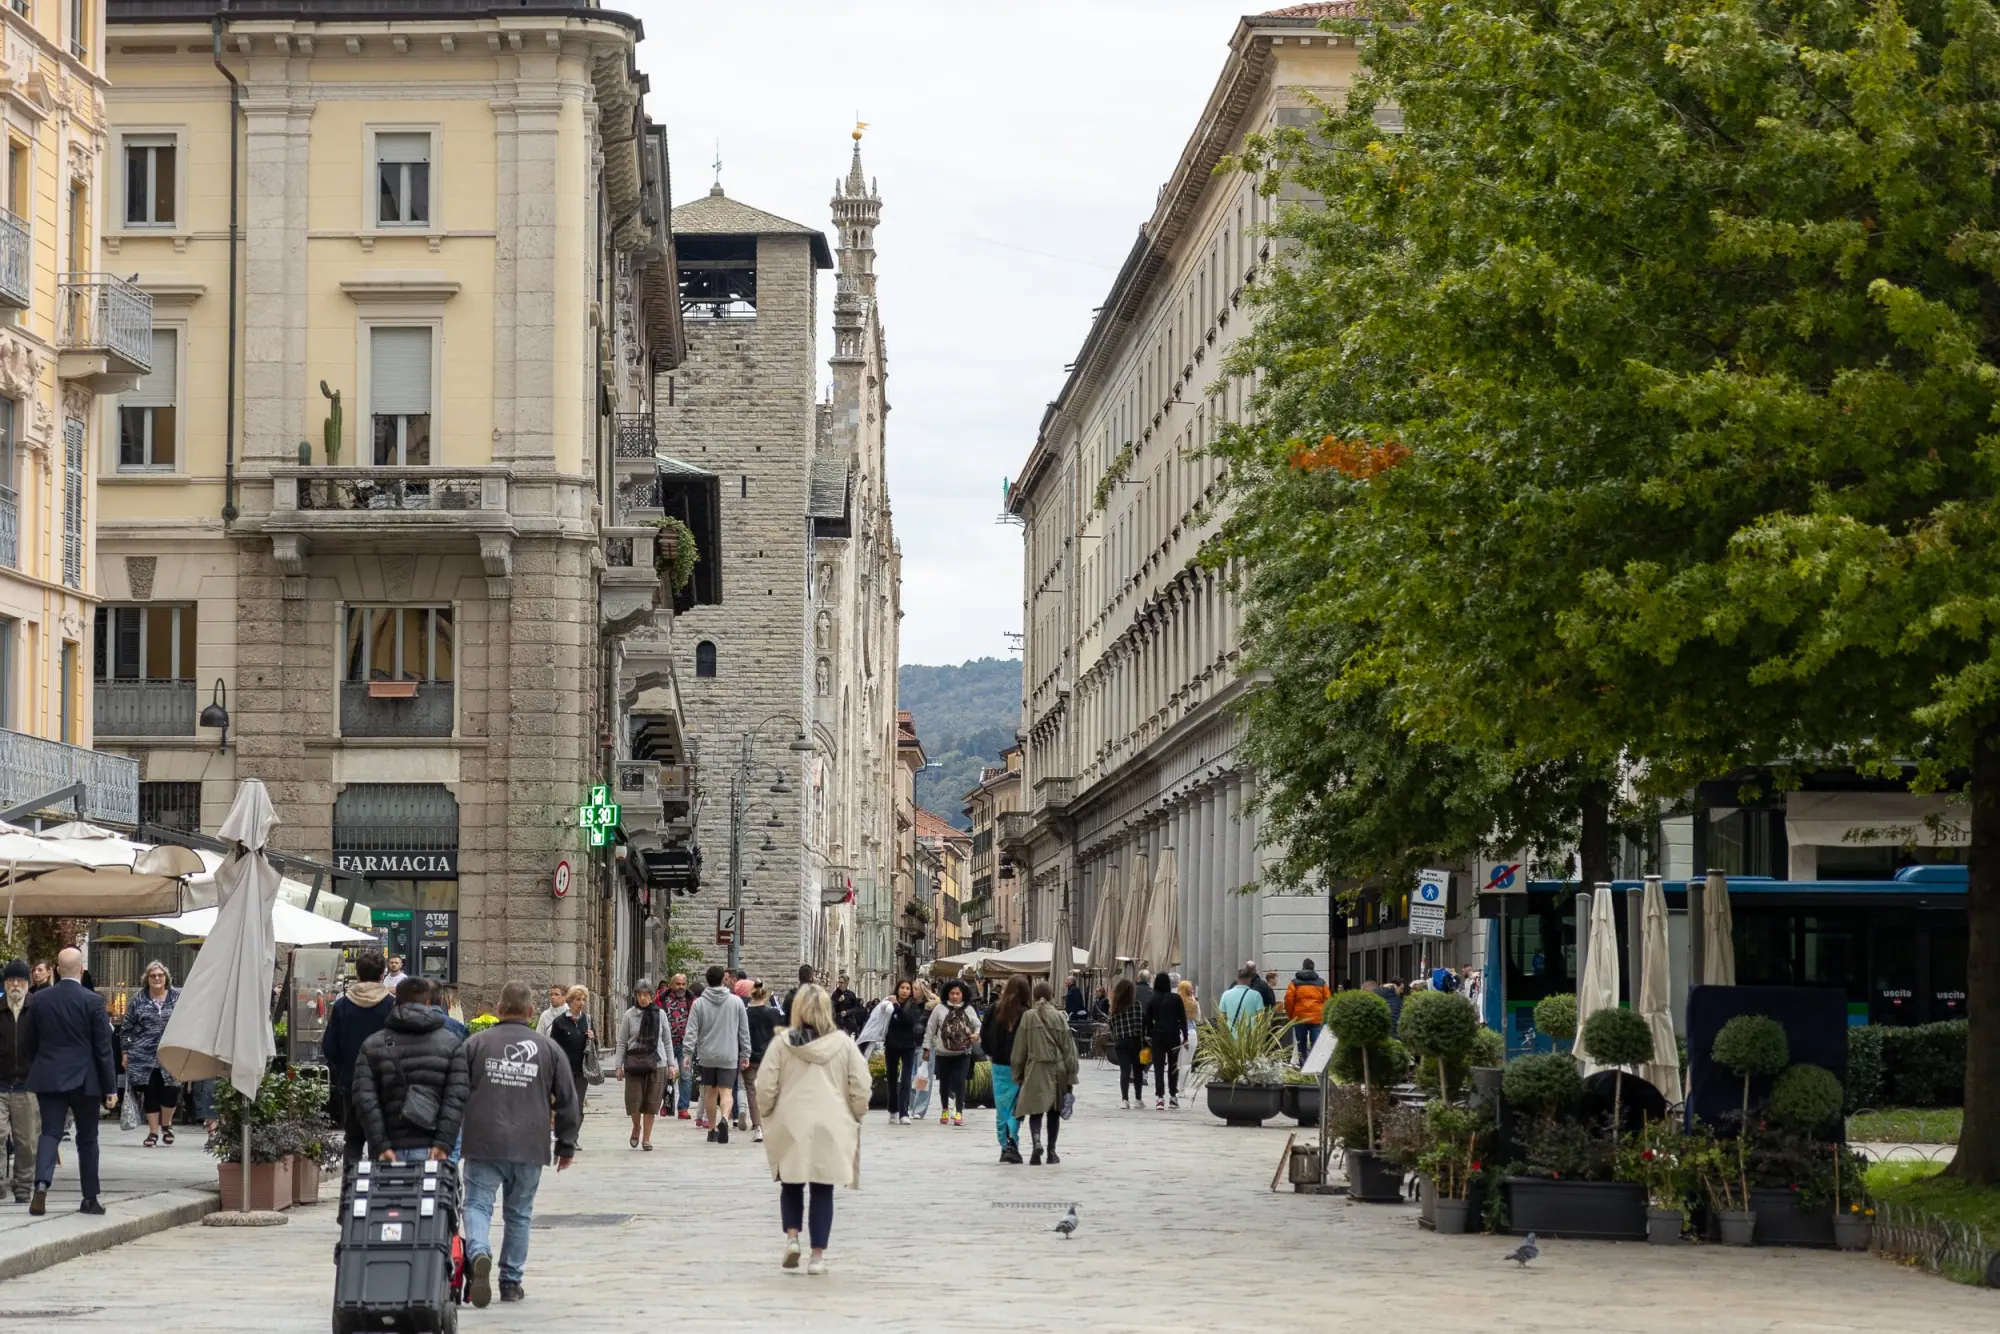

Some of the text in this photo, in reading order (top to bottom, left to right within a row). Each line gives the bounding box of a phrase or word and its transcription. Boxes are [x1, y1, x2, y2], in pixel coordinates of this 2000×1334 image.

[338, 856, 451, 872] FARMACIA
[1883, 989, 1912, 998] uscita
[1936, 991, 1965, 999] uscita
